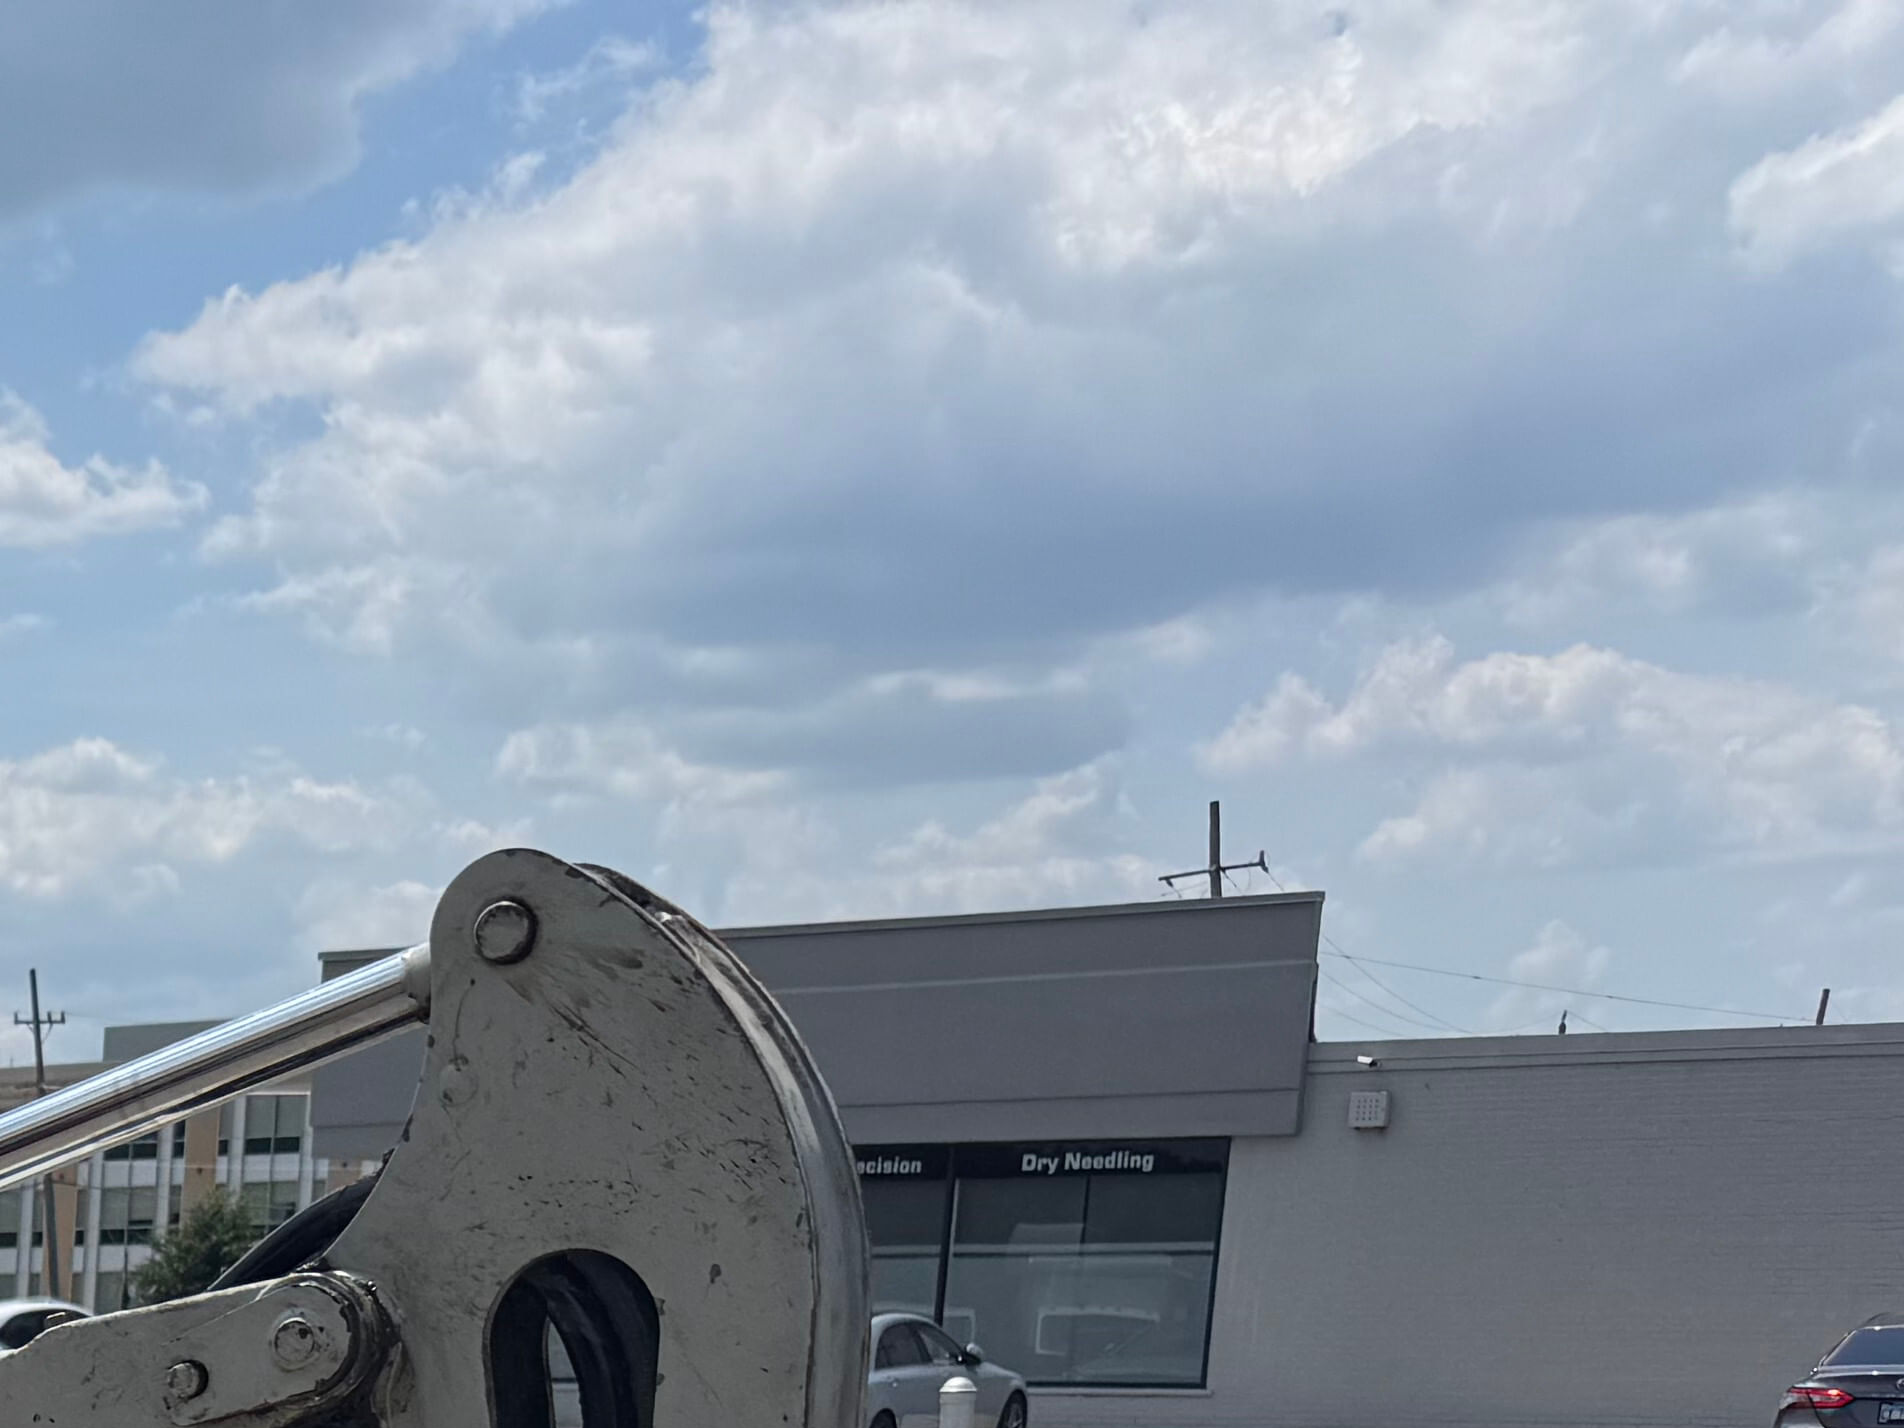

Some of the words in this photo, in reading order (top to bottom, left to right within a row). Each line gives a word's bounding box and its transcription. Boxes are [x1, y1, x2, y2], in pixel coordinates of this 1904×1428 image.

[857, 1155, 922, 1174] ecision
[1021, 1153, 1059, 1174] Dry
[1064, 1151, 1154, 1172] Needling
